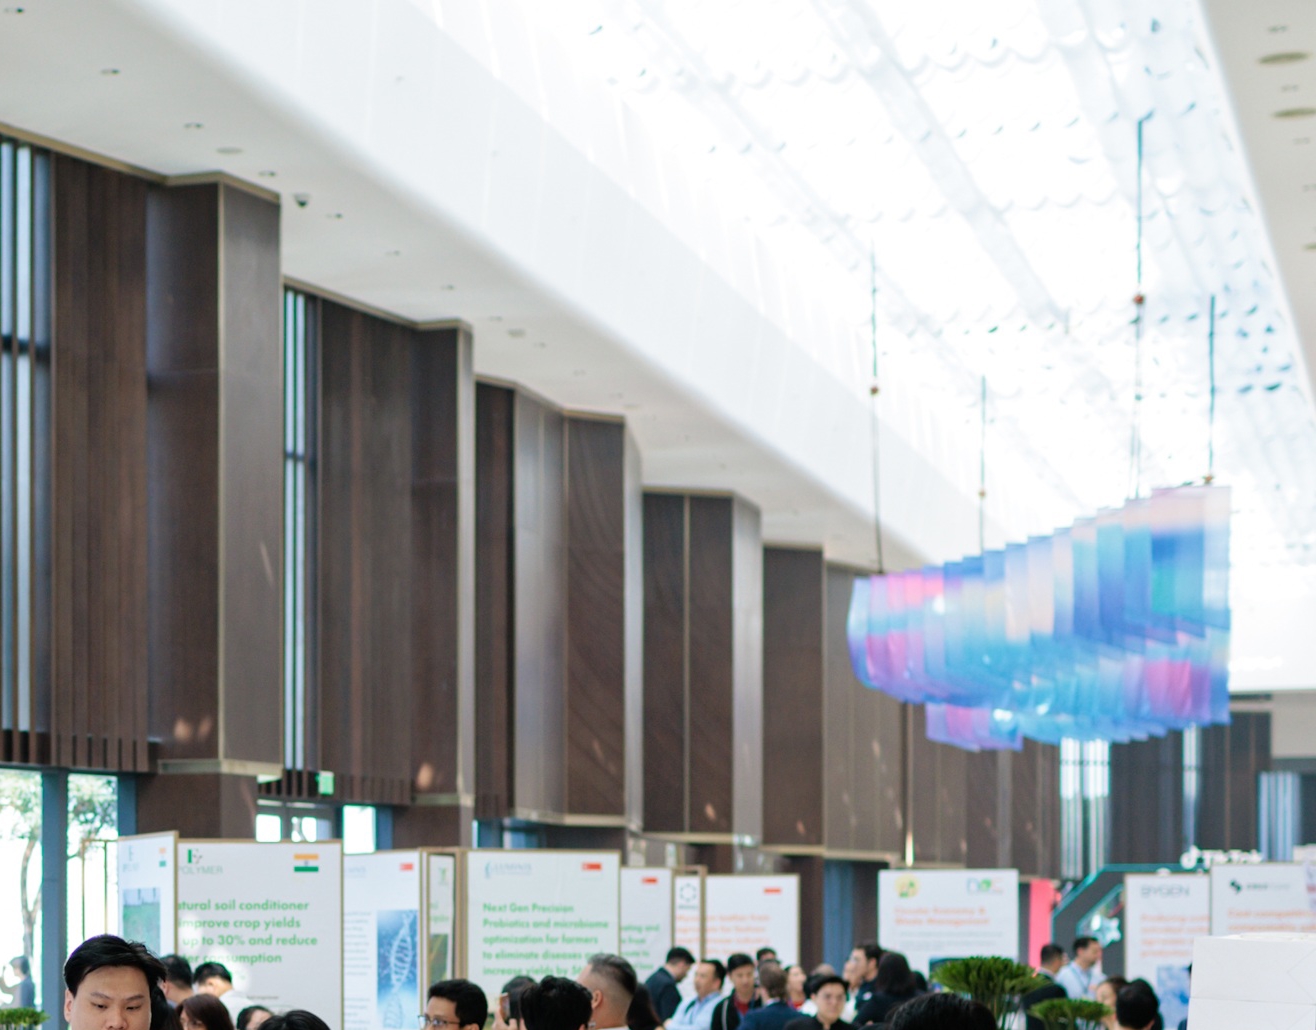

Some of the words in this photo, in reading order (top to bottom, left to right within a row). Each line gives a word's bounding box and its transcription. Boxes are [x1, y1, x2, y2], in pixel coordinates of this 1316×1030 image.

[214, 899, 236, 910] soil
[239, 899, 310, 911] conditioner
[483, 903, 507, 913] Next
[509, 903, 529, 913] Gen
[233, 920, 261, 931] crop
[264, 916, 301, 930] yields
[202, 936, 214, 946] to
[217, 935, 245, 946] 30%
[248, 935, 273, 946] and
[276, 935, 318, 946] reduce
